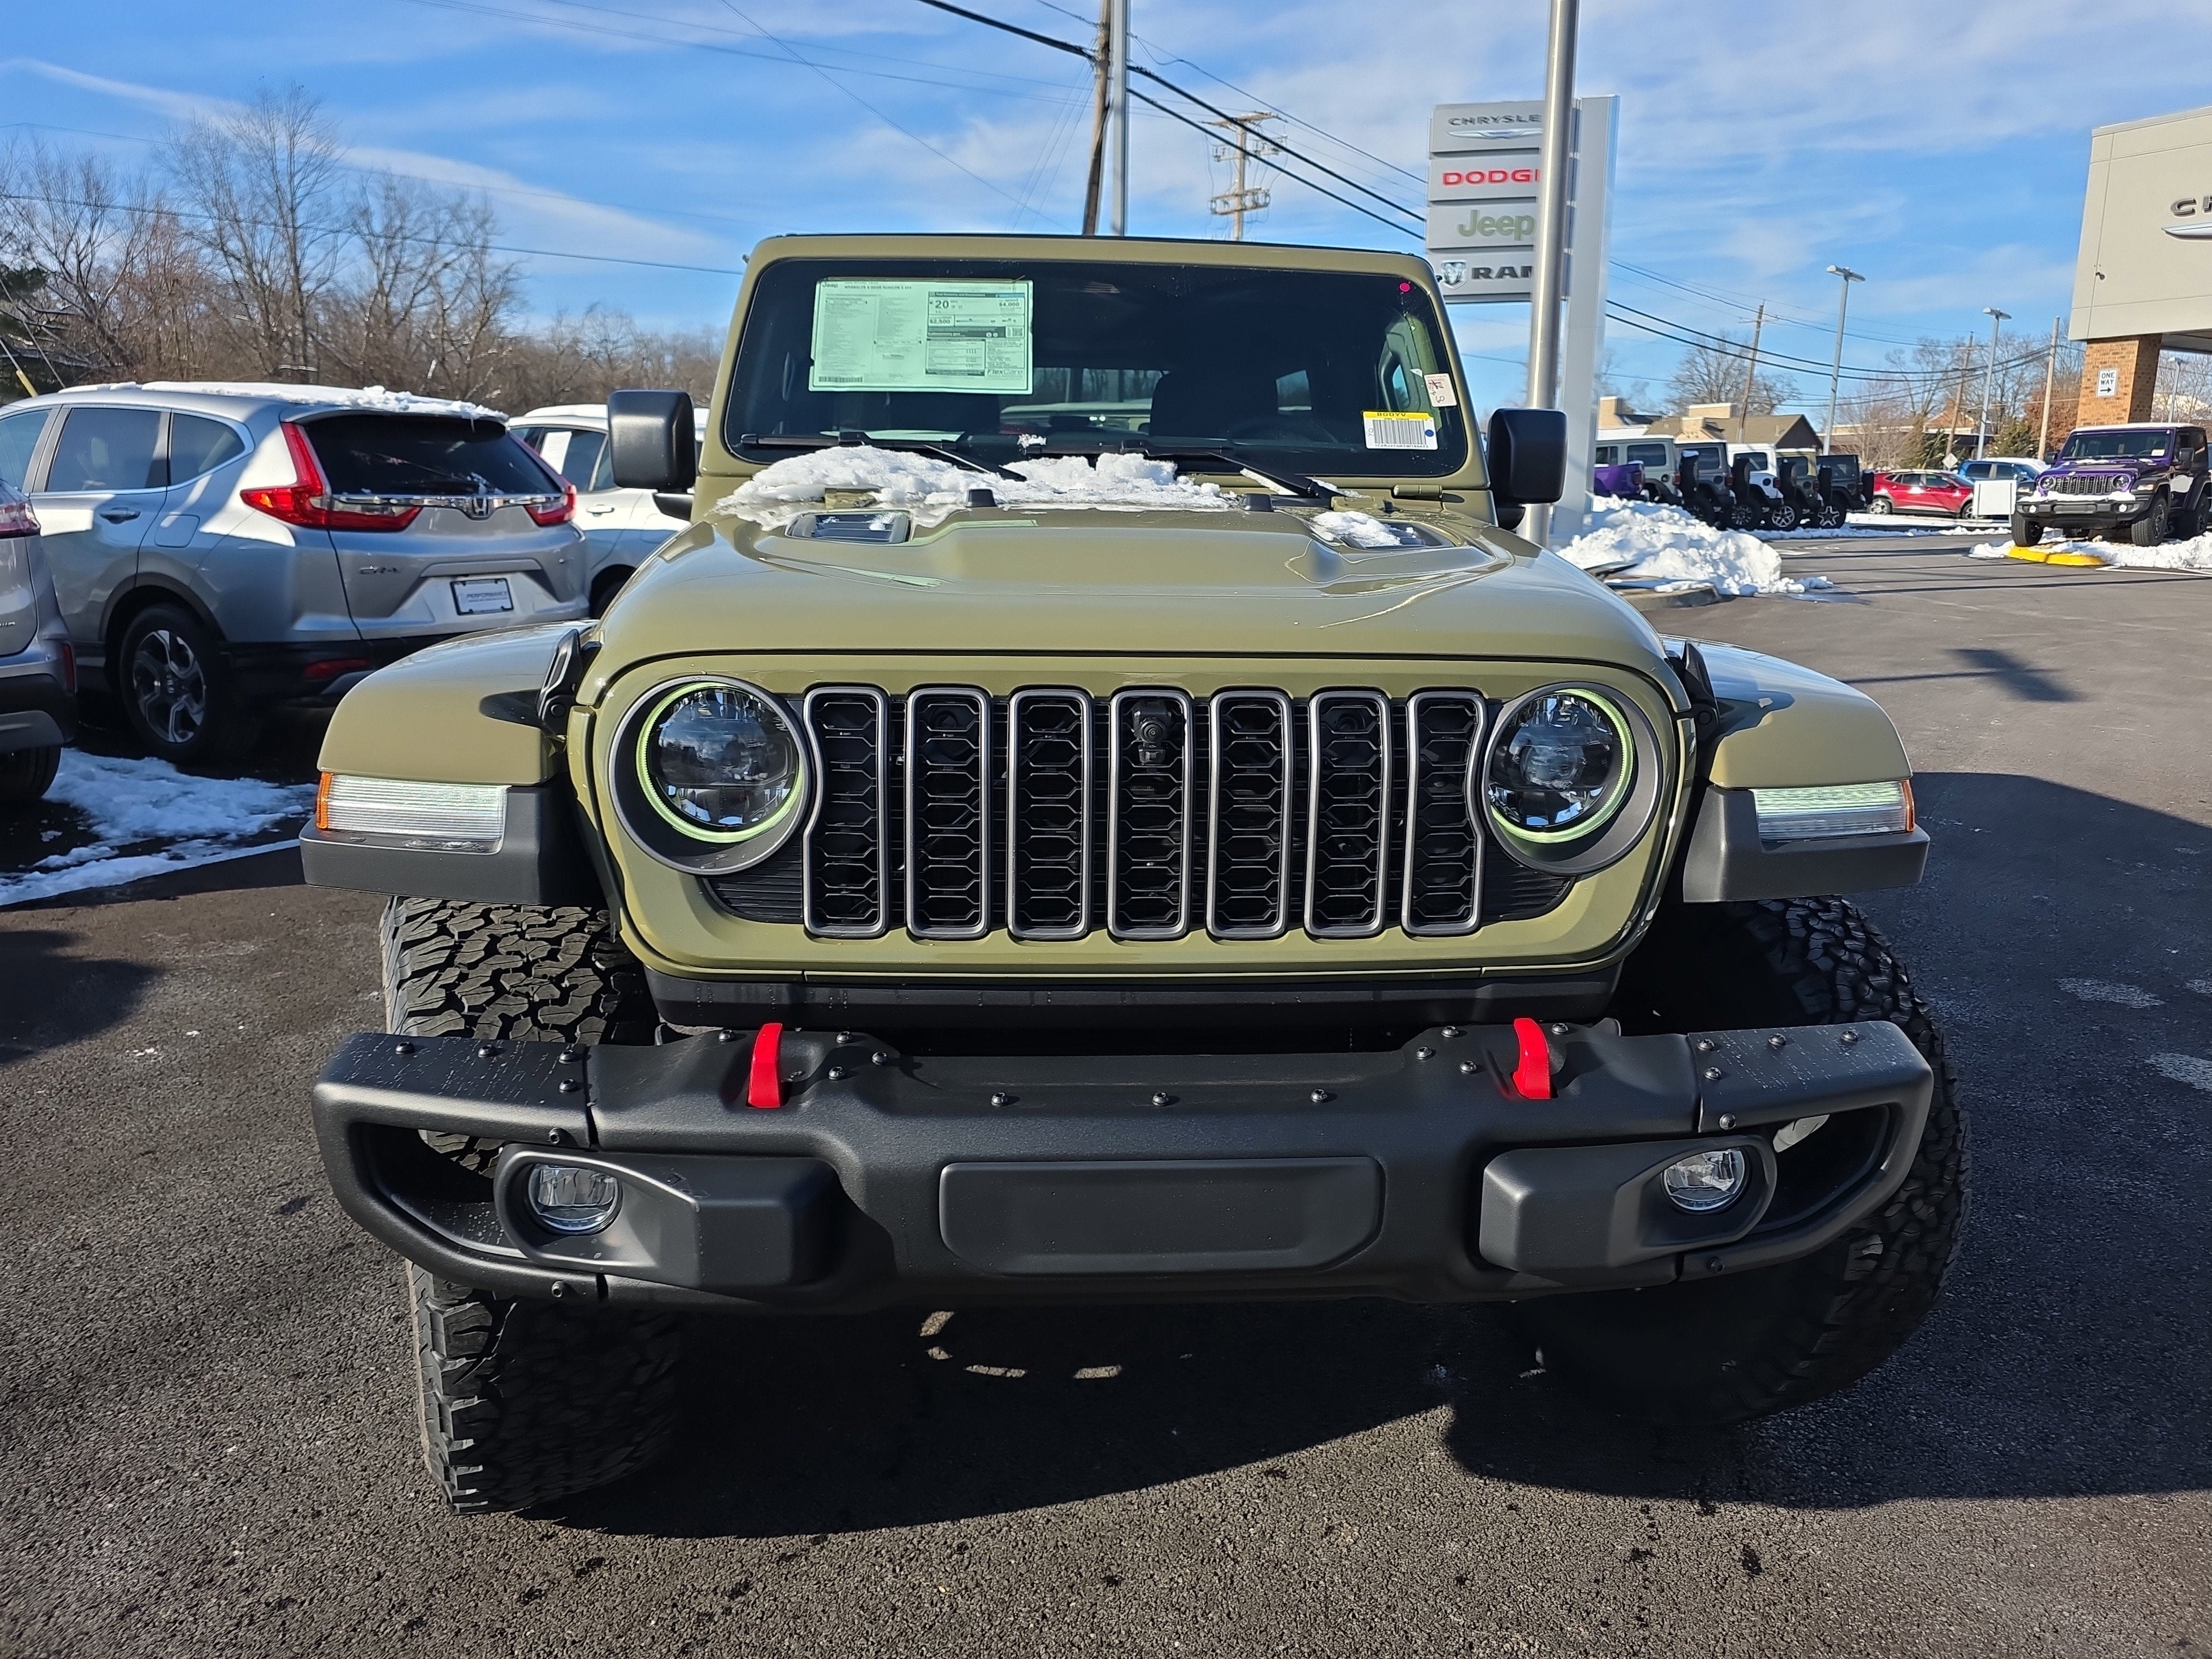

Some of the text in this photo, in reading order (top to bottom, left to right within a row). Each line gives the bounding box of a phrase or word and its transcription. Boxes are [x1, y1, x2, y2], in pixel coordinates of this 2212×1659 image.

[1449, 114, 1542, 126] CHRYSLE
[1457, 209, 1535, 241] Jeep
[935, 300, 949, 308] 20
